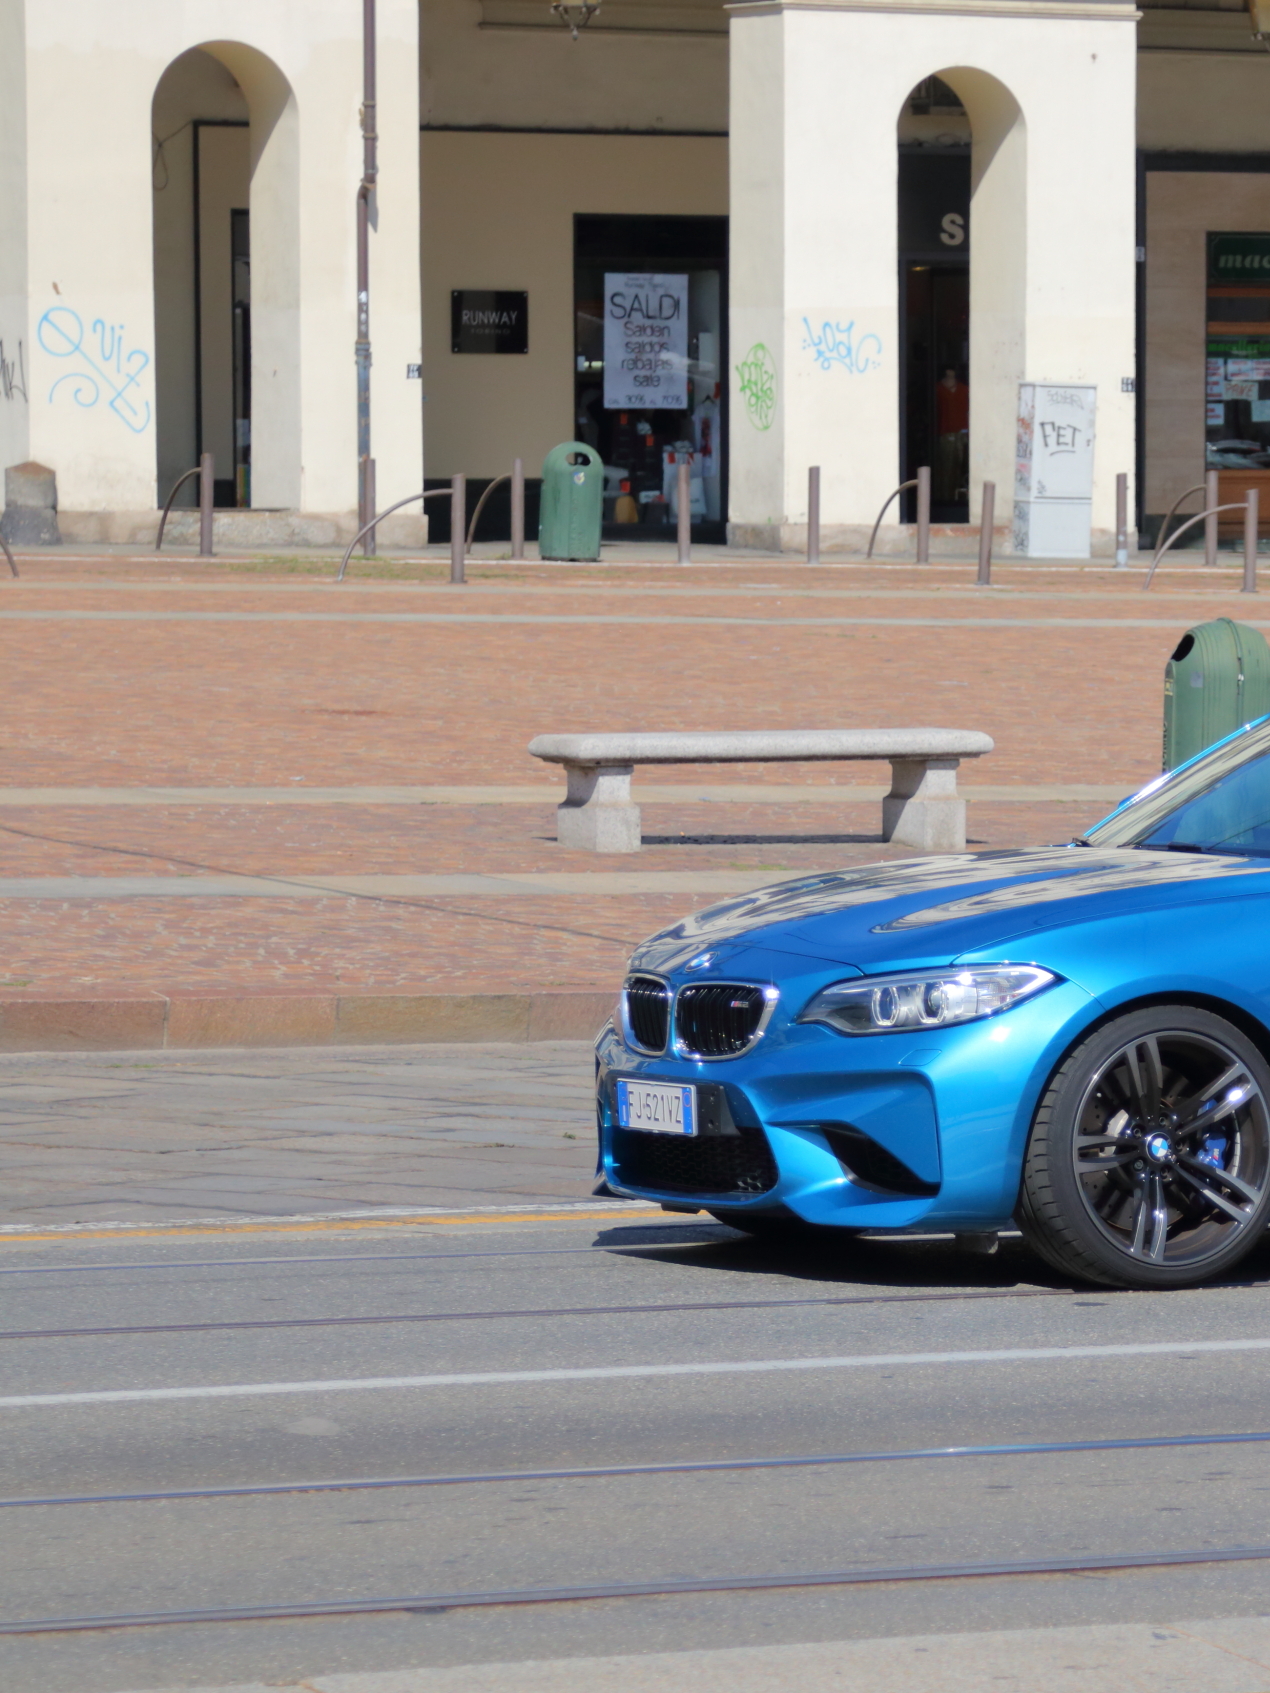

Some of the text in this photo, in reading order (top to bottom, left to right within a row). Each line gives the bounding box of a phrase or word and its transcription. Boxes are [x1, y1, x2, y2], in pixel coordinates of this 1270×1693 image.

[940, 212, 965, 246] S
[610, 291, 681, 320] SALDI
[462, 309, 518, 325] RUNWAY
[623, 320, 671, 338] Salden
[625, 341, 670, 355] saldos
[621, 356, 674, 373] rebajas
[633, 374, 662, 388] sale
